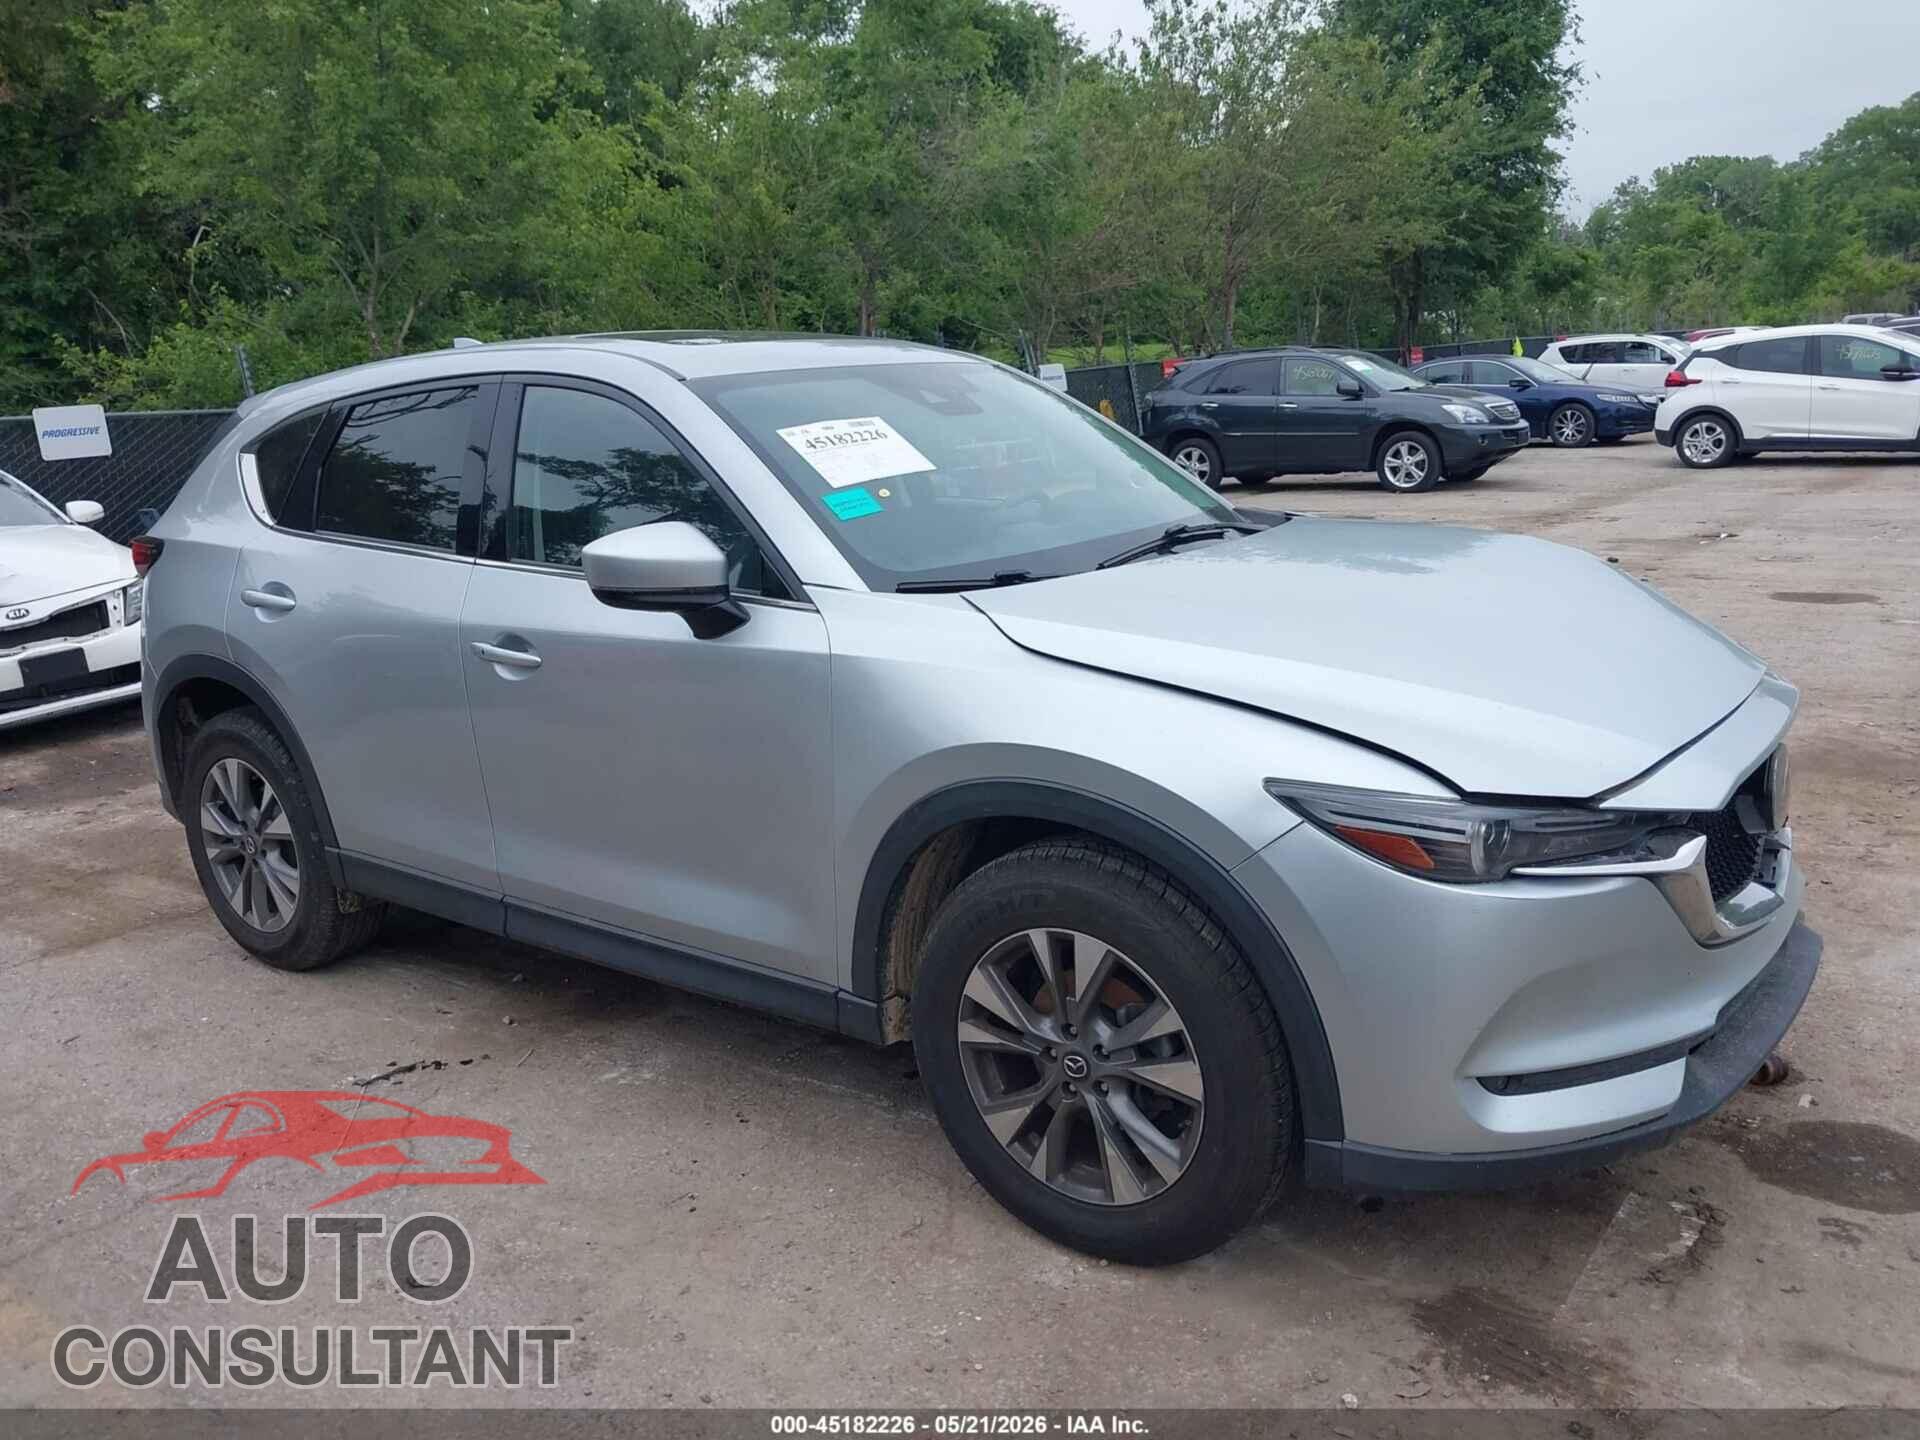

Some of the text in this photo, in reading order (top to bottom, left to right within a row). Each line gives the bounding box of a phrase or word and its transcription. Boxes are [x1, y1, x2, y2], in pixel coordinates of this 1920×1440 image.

[42, 426, 100, 439] PROGRESSIVE
[805, 429, 888, 449] 45182226
[8, 609, 28, 618] KIA
